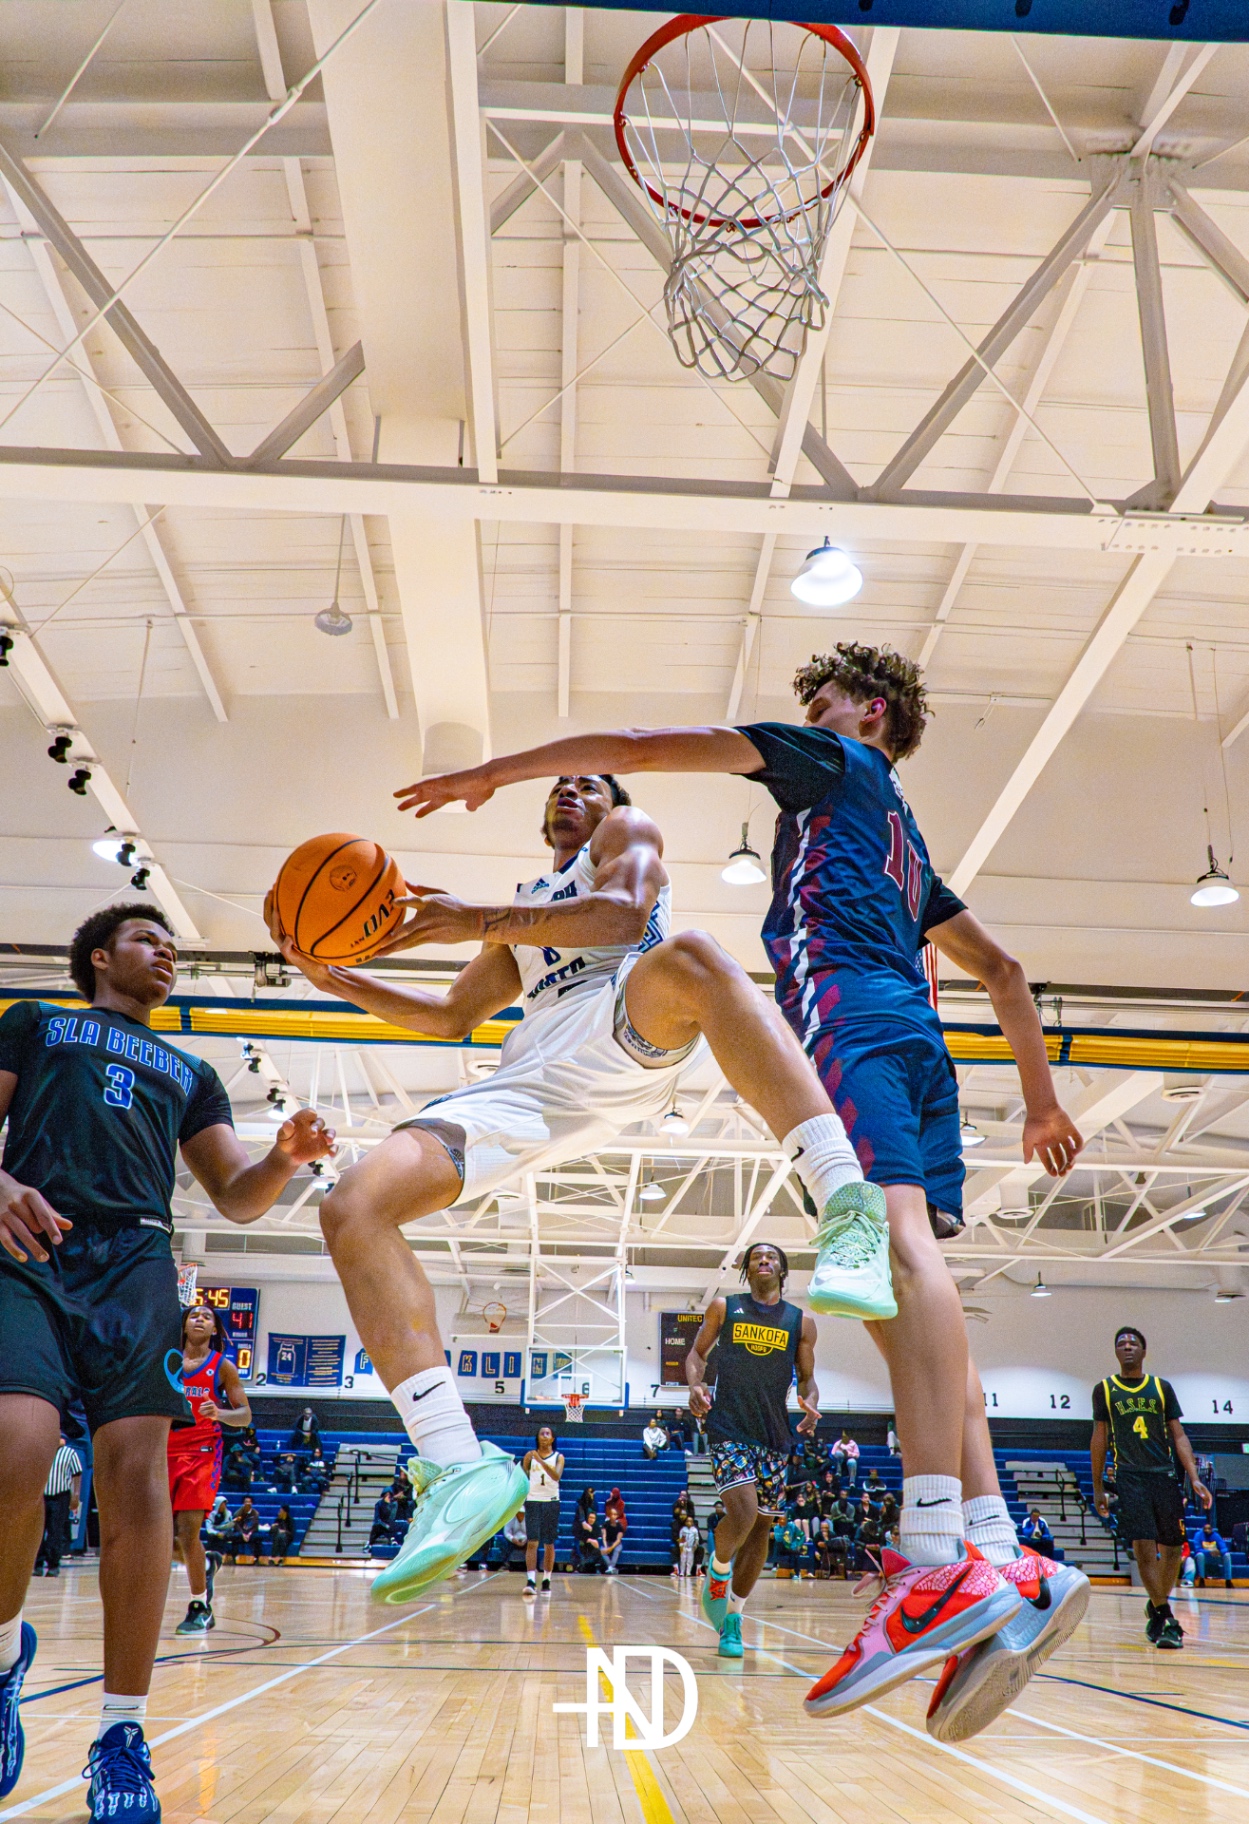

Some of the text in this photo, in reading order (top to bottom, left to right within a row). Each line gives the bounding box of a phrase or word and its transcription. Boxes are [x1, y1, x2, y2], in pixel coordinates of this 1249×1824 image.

[884, 811, 923, 922] 10
[45, 1017, 194, 1097] SLA BEEBER
[103, 1063, 136, 1110] 3
[664, 1337, 686, 1346] HOME
[734, 1324, 787, 1346] SANKOFA
[256, 1372, 267, 1387] 2
[344, 1376, 355, 1389] 3
[494, 1381, 505, 1394] 5
[650, 1384, 661, 1398] 7
[1050, 1394, 1071, 1409] 12
[1212, 1399, 1234, 1415] 14
[1132, 1415, 1149, 1439] 4
